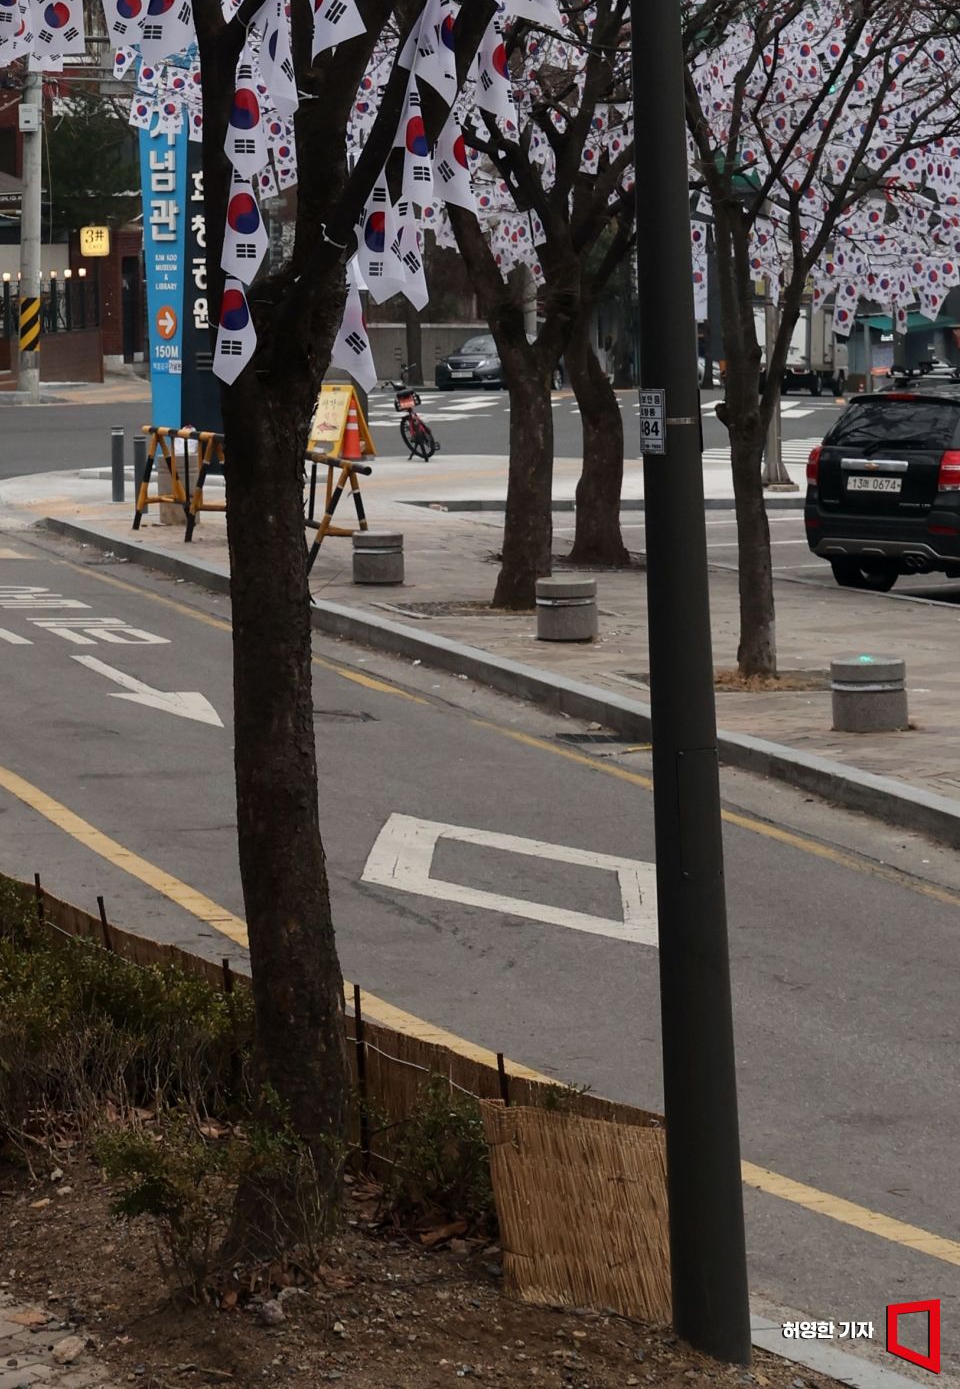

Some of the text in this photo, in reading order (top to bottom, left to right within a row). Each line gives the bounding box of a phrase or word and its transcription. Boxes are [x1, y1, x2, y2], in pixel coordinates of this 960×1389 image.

[155, 283, 178, 291] LIBRARY
[155, 345, 179, 358] 150M
[872, 479, 896, 490] 0674
